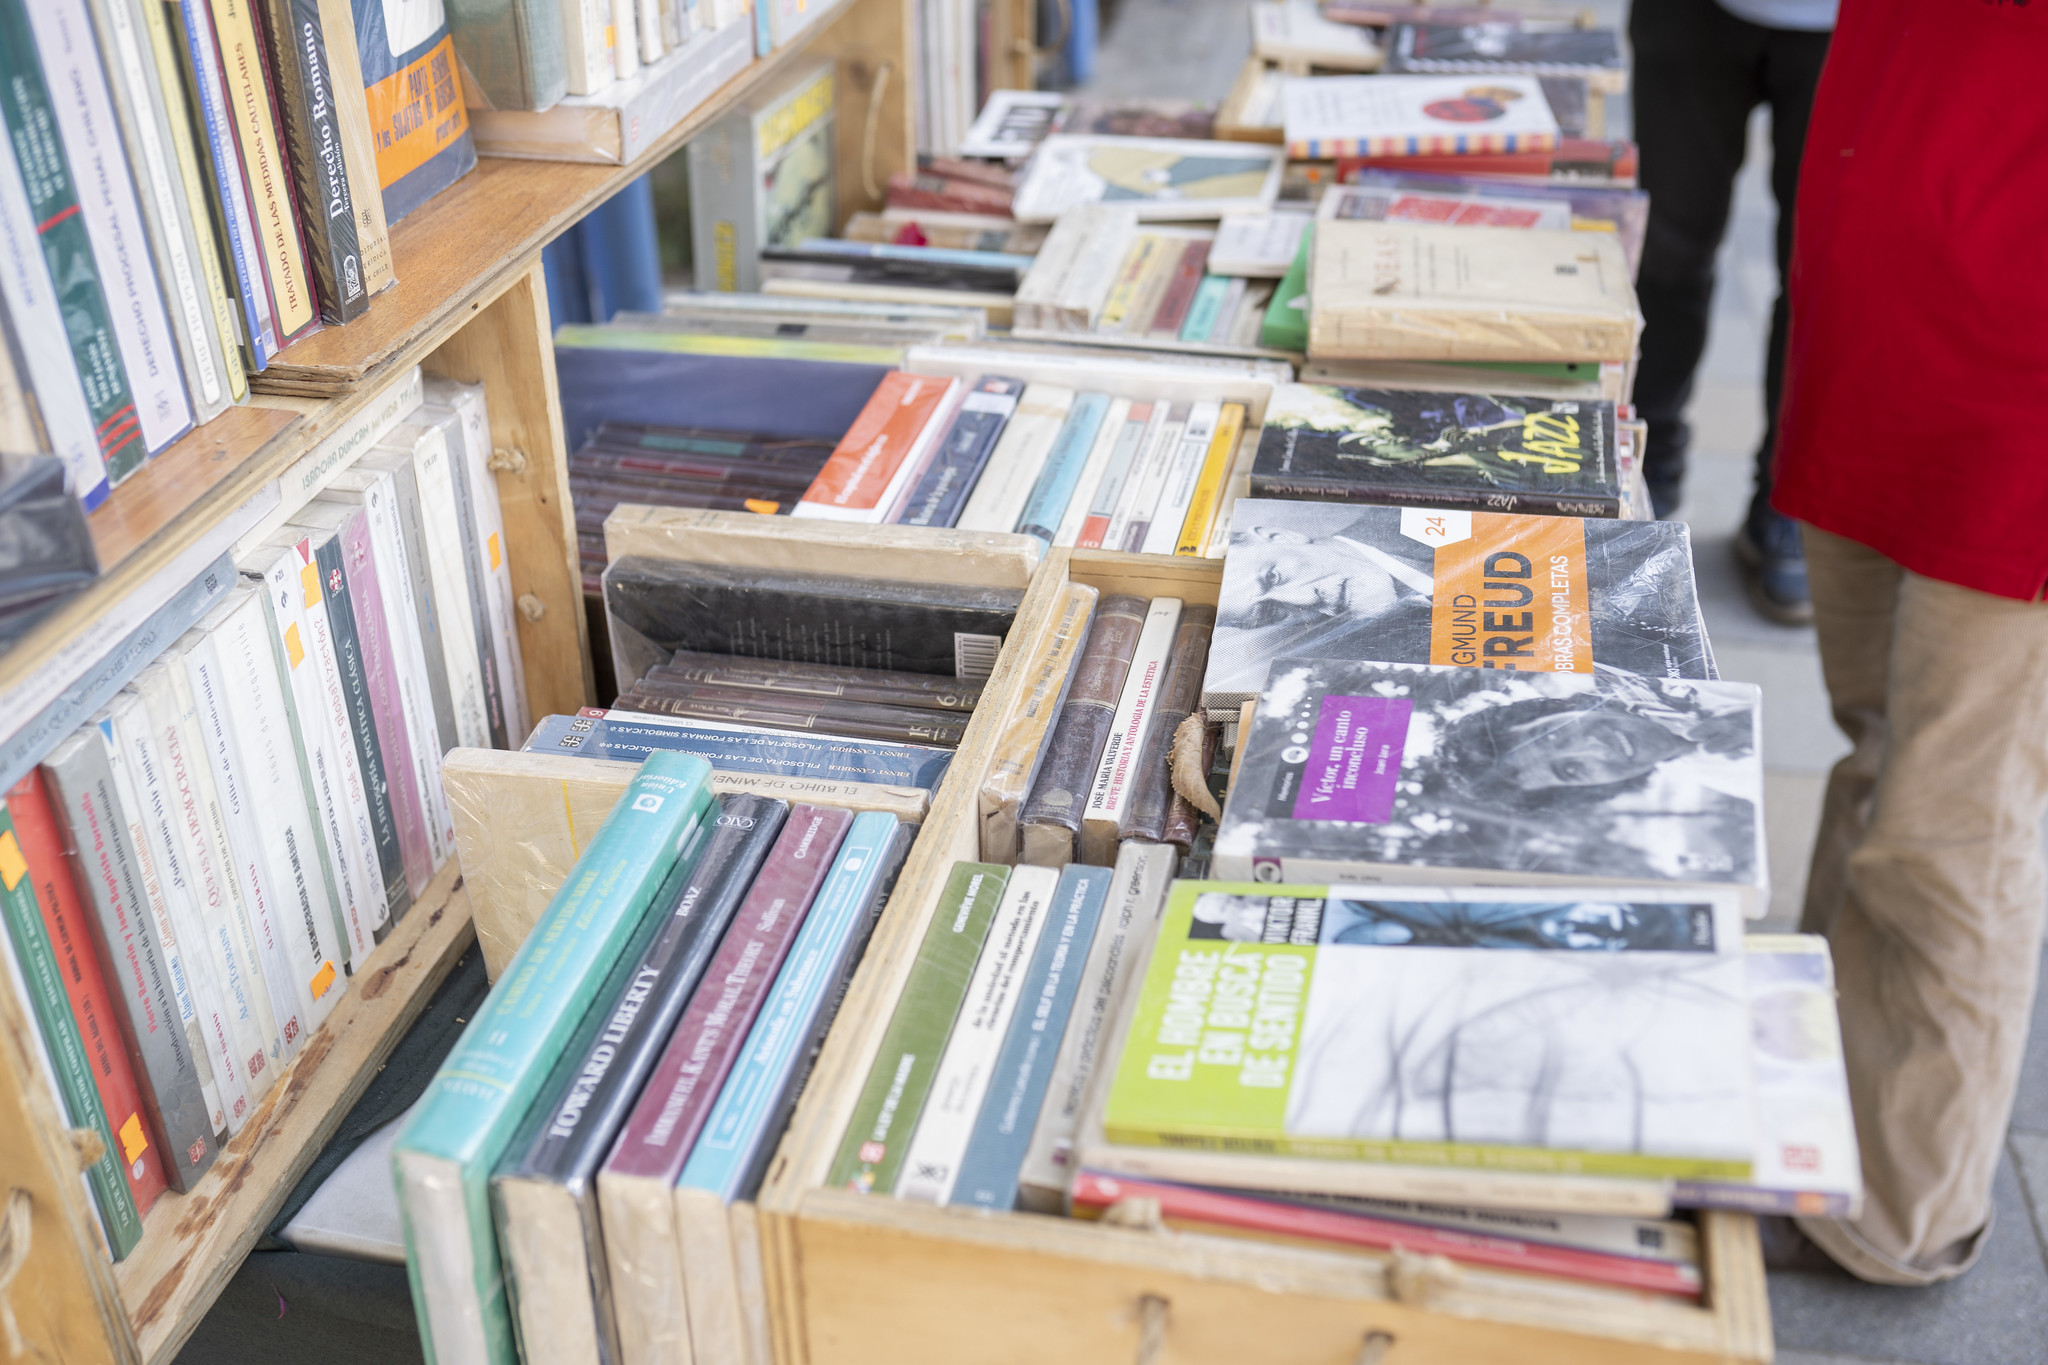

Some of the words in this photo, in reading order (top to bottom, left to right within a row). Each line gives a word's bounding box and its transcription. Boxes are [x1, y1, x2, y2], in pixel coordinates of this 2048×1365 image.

[299, 21, 328, 121] Romano
[230, 41, 262, 135] CAUTELARES
[252, 135, 275, 199] MEDIDAS
[316, 124, 344, 220] Derecho
[267, 200, 281, 227] LAS
[273, 227, 285, 248] DE
[276, 248, 300, 312] TRATADO
[129, 298, 159, 378] DERECHO
[337, 423, 368, 460] DUNCAN
[1499, 412, 1582, 476] JAZZ
[1485, 493, 1517, 511] JAZZ
[1425, 516, 1446, 536] 24
[1550, 554, 1572, 635] COMPLETAS
[311, 617, 347, 727] globalización?
[342, 637, 361, 695] CLÁSICA
[1145, 660, 1159, 690] ESTÉTICA
[197, 664, 224, 738] modernidad
[1138, 695, 1146, 708] DE
[337, 730, 349, 748] la
[353, 693, 373, 757] POLÍTICA
[617, 725, 680, 739] SIMBÓLICAS
[681, 731, 726, 742] FORMAS
[1121, 710, 1150, 745] ANTOLOGÍA
[1334, 710, 1352, 744] canto
[216, 740, 226, 754] la
[727, 735, 750, 744] LAS
[749, 737, 765, 746] DE
[766, 739, 823, 752] FILOSOFÍA
[828, 744, 877, 756] CASSIRER
[1101, 732, 1126, 764] VALVERDE
[220, 756, 230, 771] de
[342, 749, 354, 768] es
[724, 752, 748, 762] LAS
[748, 755, 763, 764] DE
[763, 756, 821, 771] FILOSOFÍA
[878, 749, 910, 759] ERNST
[1328, 746, 1344, 762] un
[1336, 726, 1368, 790] inconcluso
[636, 774, 687, 789] Editorial
[827, 762, 877, 775] CASSIRER
[876, 767, 910, 779] ERNST
[1095, 767, 1115, 788] MARÍA
[1110, 753, 1136, 784] HISTORIA
[346, 770, 362, 805] ¿Qué
[789, 779, 837, 795] BUHO
[842, 785, 858, 796] EL
[1089, 793, 1106, 808] JOSÉ
[1103, 788, 1124, 809] BREVE
[716, 815, 754, 829] CATO
[281, 824, 302, 874] AMÉRICA
[791, 816, 824, 857] CAMBRIDGE
[96, 851, 122, 904] Baptiste
[118, 863, 142, 918] relaciones
[144, 878, 160, 898] del
[294, 871, 304, 886] EN
[149, 894, 167, 919] salir
[674, 887, 704, 916] BOAZ
[133, 917, 146, 935] las
[296, 885, 320, 951] DEMOCRACIA
[1263, 896, 1296, 944] VIKTOR
[1290, 898, 1324, 946] FRANKL
[122, 931, 133, 943] y
[139, 934, 150, 949] de
[122, 942, 148, 998] Renouvin
[142, 948, 162, 990] historia
[312, 948, 323, 965] LA
[165, 954, 188, 997] Touraine
[154, 988, 165, 1001] la
[159, 999, 167, 1008] a
[1156, 948, 1221, 1046] HOMBRE
[1206, 952, 1264, 1028] BUSCA
[1248, 954, 1308, 1050] SENTIDO
[138, 995, 159, 1035] Pierre
[177, 992, 194, 1020] Alain
[160, 1008, 187, 1071] Introducción
[546, 1047, 619, 1135] TOWARD
[600, 969, 662, 1041] LIBERTY
[1197, 1029, 1246, 1066] EN
[1146, 1049, 1196, 1082] EL
[1238, 1052, 1289, 1088] DE
[106, 1171, 118, 1189] EL
[111, 1186, 126, 1212] QUE
